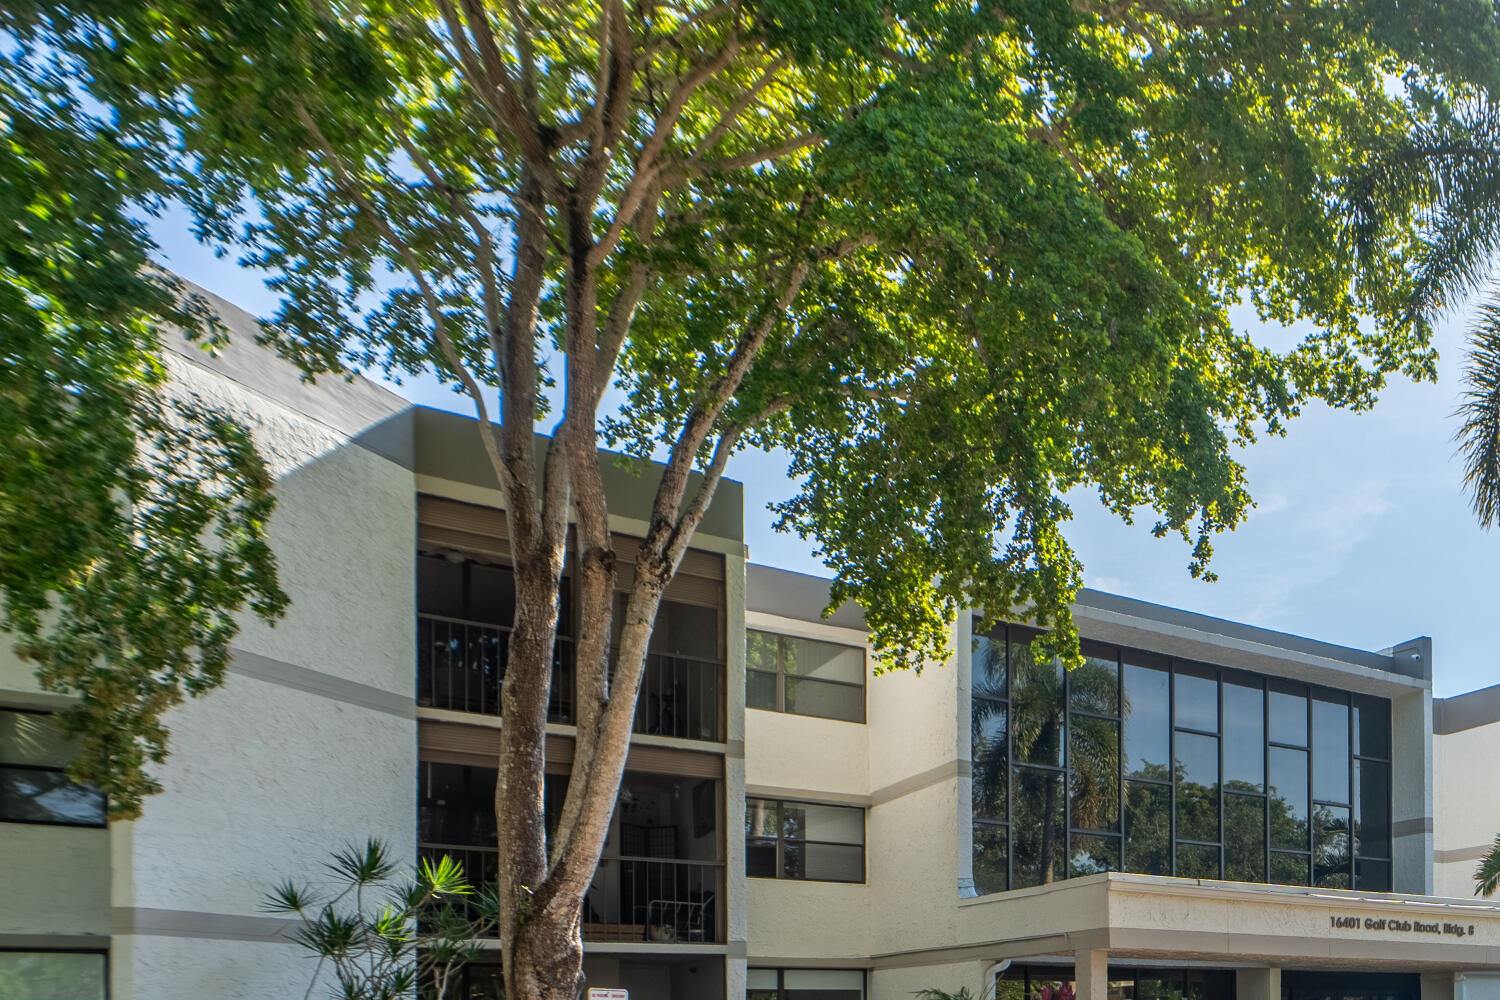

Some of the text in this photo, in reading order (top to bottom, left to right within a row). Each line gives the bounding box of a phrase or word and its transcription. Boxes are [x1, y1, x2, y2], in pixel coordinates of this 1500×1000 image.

[1331, 916, 1360, 929] 16401
[1364, 918, 1386, 930] Golf
[1388, 919, 1411, 932] Club
[1414, 921, 1441, 935] Road,
[1443, 923, 1466, 937] Bldg.
